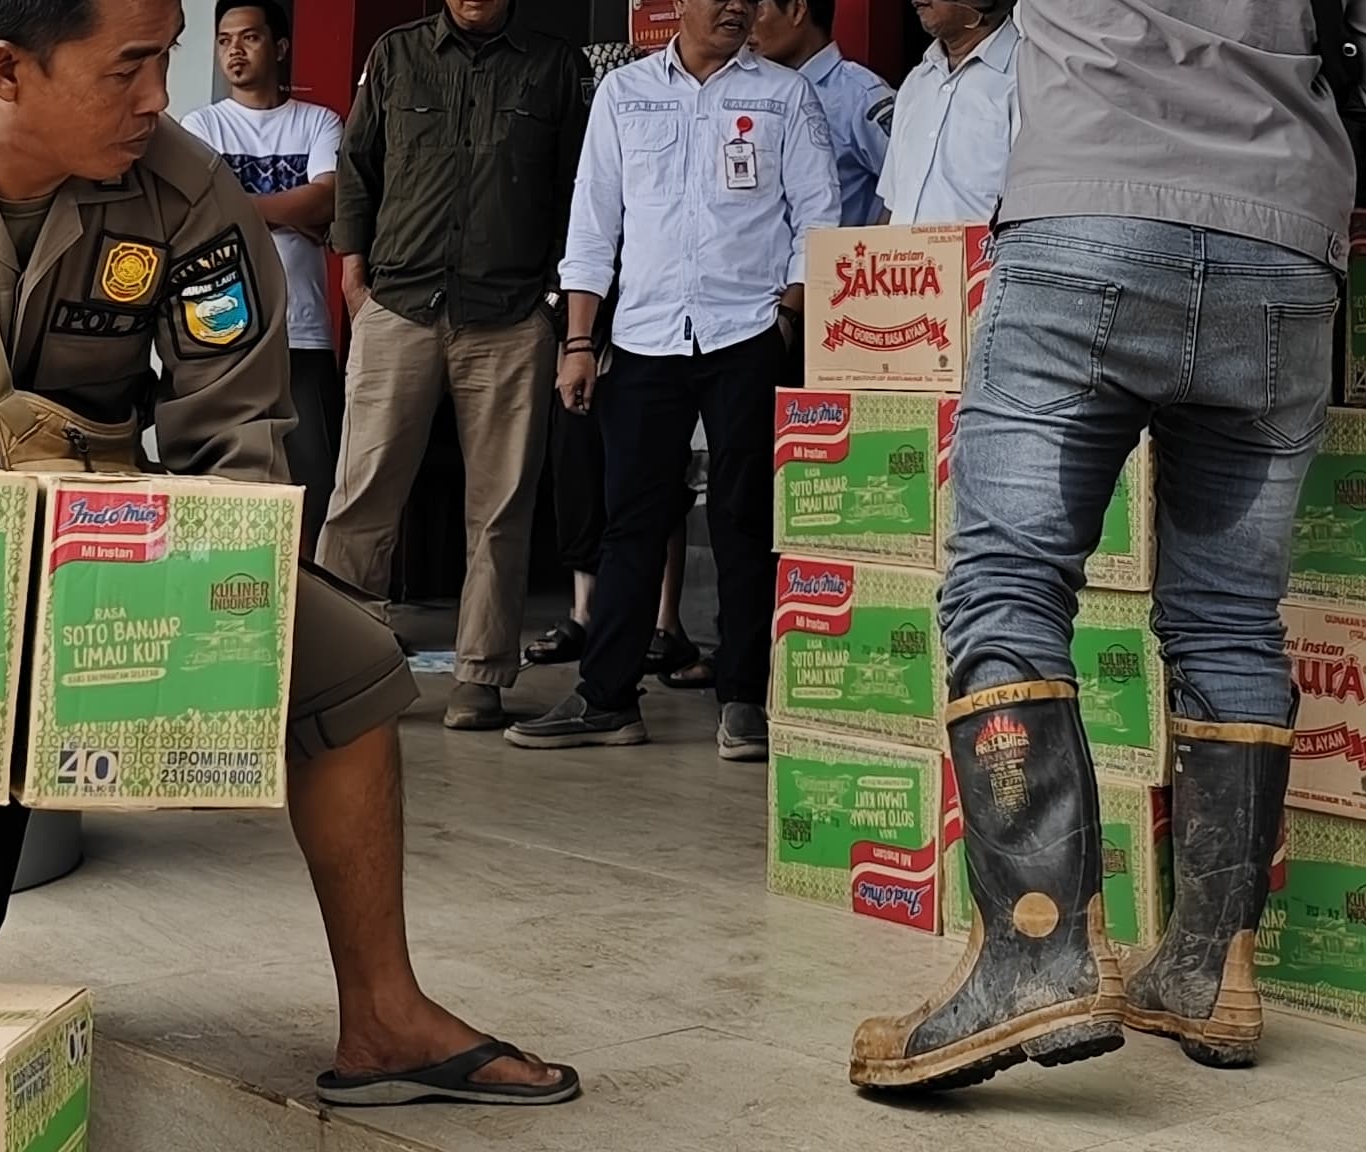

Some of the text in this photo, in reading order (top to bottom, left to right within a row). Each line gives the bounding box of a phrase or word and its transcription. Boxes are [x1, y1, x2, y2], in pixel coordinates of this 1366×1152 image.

[790, 481, 812, 497] SOTO
[211, 581, 269, 599] KULINER
[210, 596, 270, 611] INDONESIA
[95, 607, 126, 620] RASA
[63, 617, 181, 646] SOTO BANJAR
[74, 640, 171, 668] LIMAU KUIT
[1301, 640, 1344, 656] instan
[792, 652, 813, 667] SOTO
[1315, 733, 1346, 752] AYAM
[167, 751, 213, 766] BPOM
[237, 752, 259, 766] MD
[58, 750, 119, 784] 40
[161, 769, 262, 785] 231509018002
[888, 810, 914, 827] SOTO
